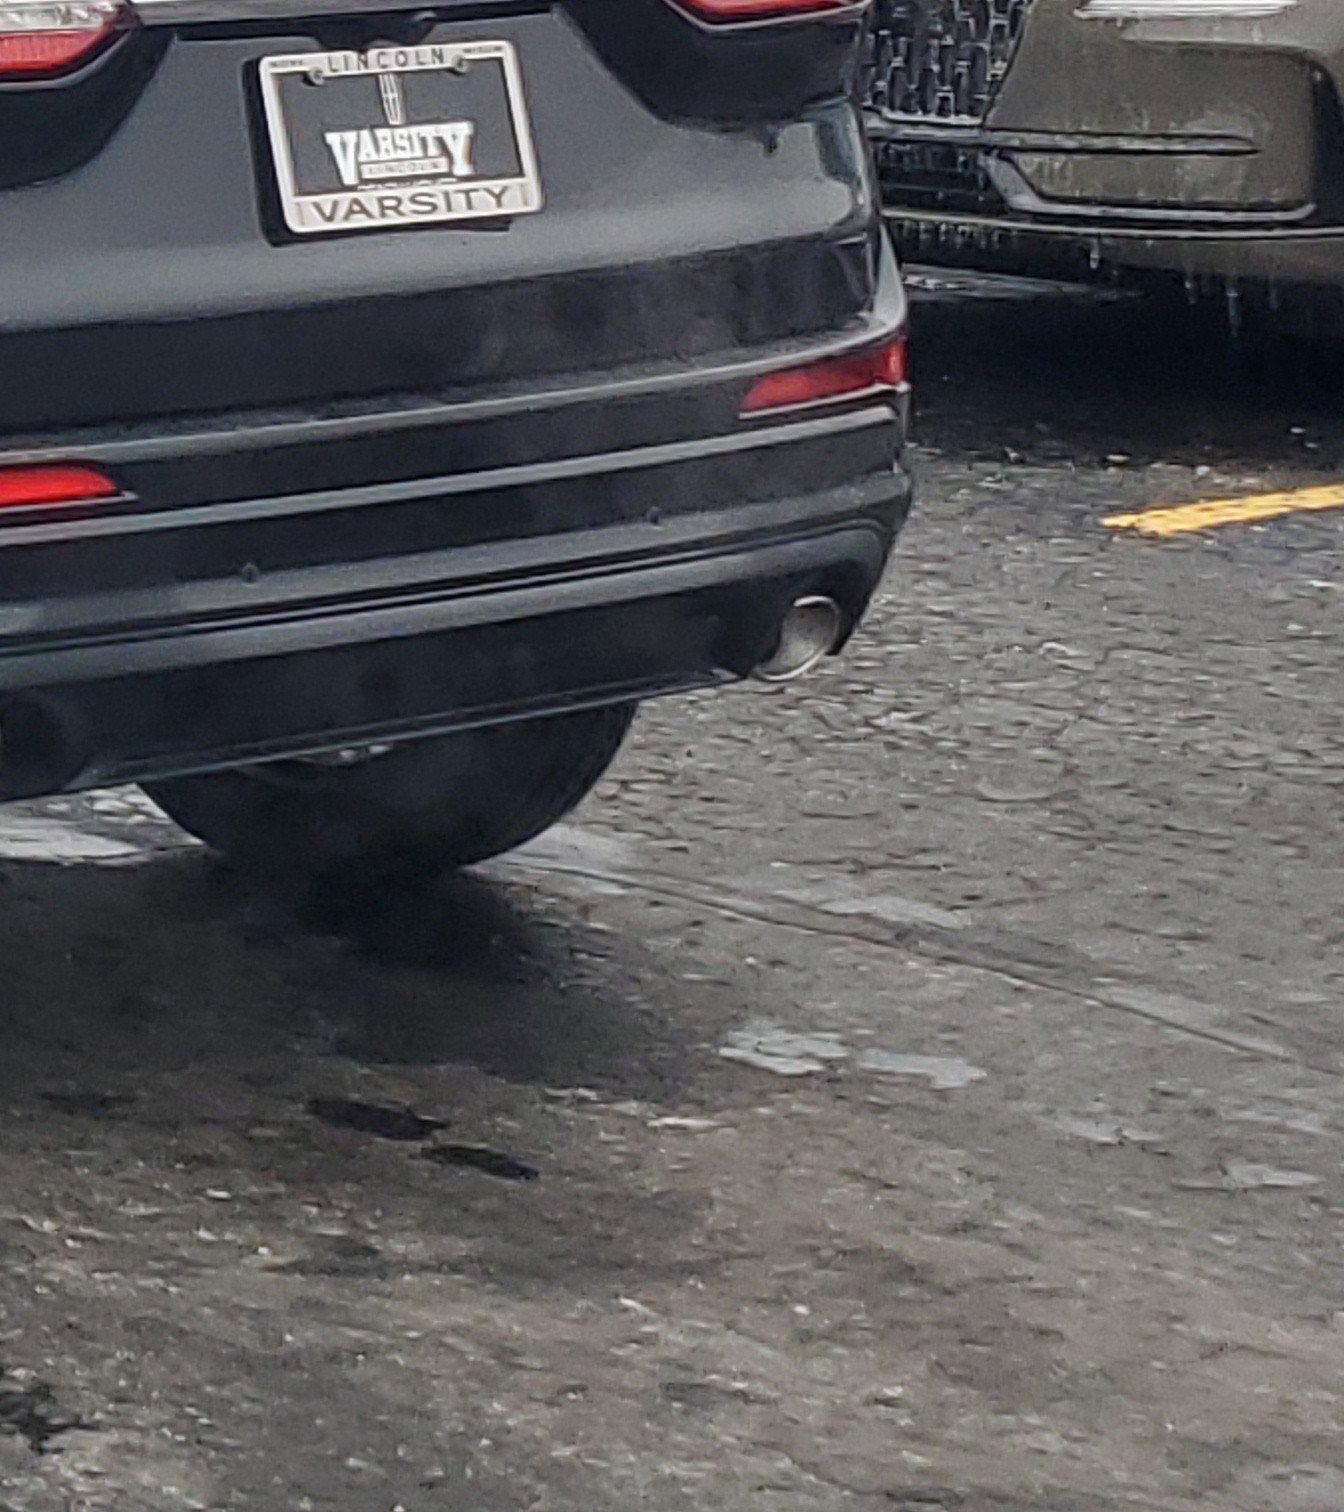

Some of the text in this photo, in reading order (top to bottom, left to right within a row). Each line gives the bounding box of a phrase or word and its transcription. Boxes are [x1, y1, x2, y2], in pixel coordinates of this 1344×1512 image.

[327, 47, 444, 73] LINCOLN
[324, 121, 473, 186] VARSITY
[313, 185, 509, 223] VARSITY
